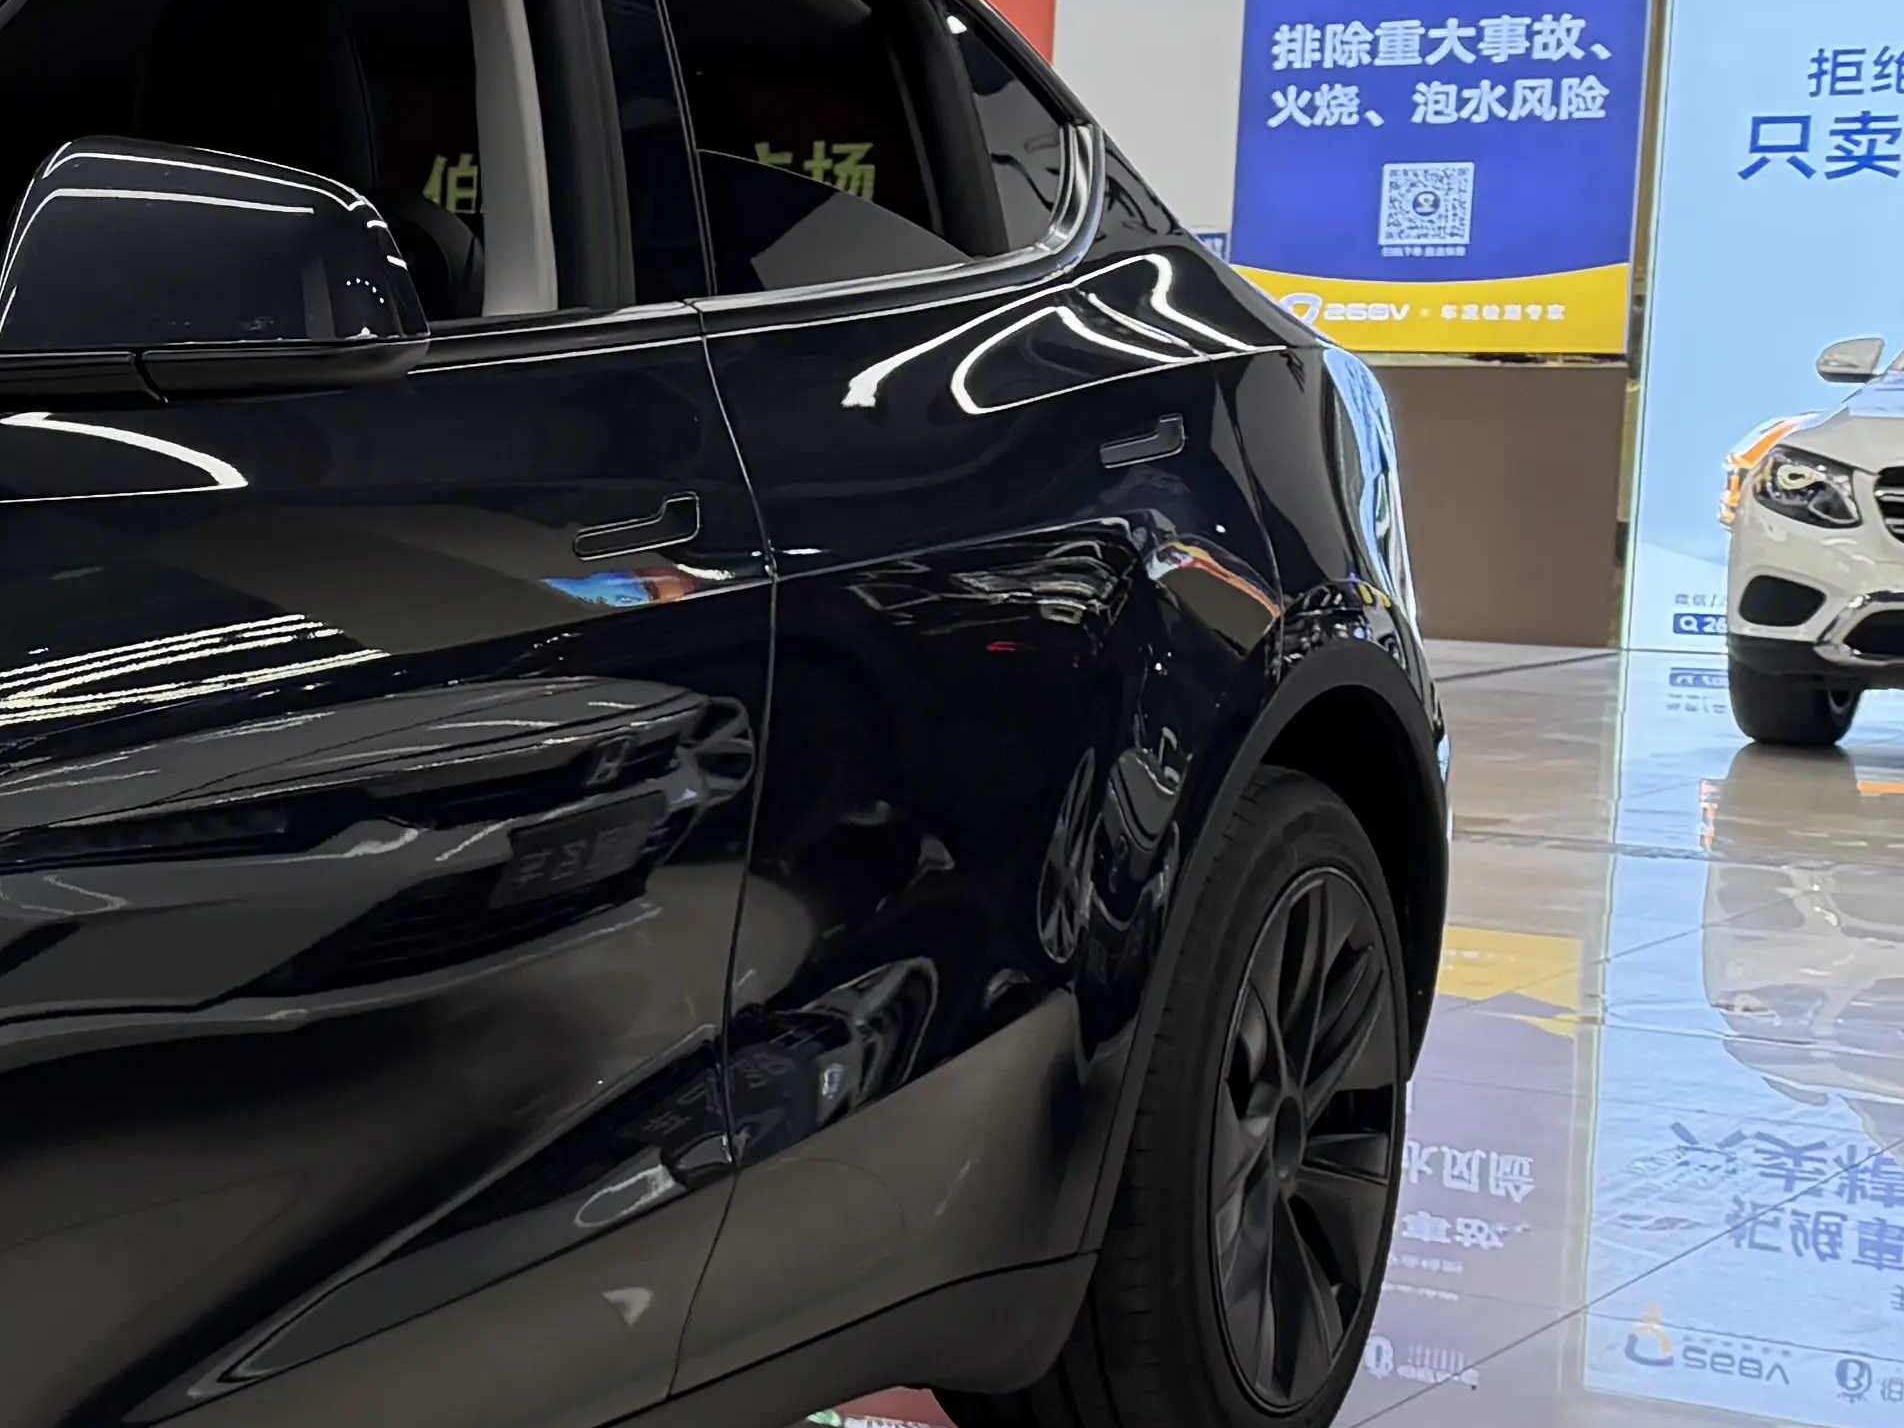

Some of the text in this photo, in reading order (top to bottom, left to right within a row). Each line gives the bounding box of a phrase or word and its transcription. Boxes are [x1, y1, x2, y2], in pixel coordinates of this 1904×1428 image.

[1272, 12, 1613, 71] 排除重大事故、
[1737, 110, 1903, 180] 只卖
